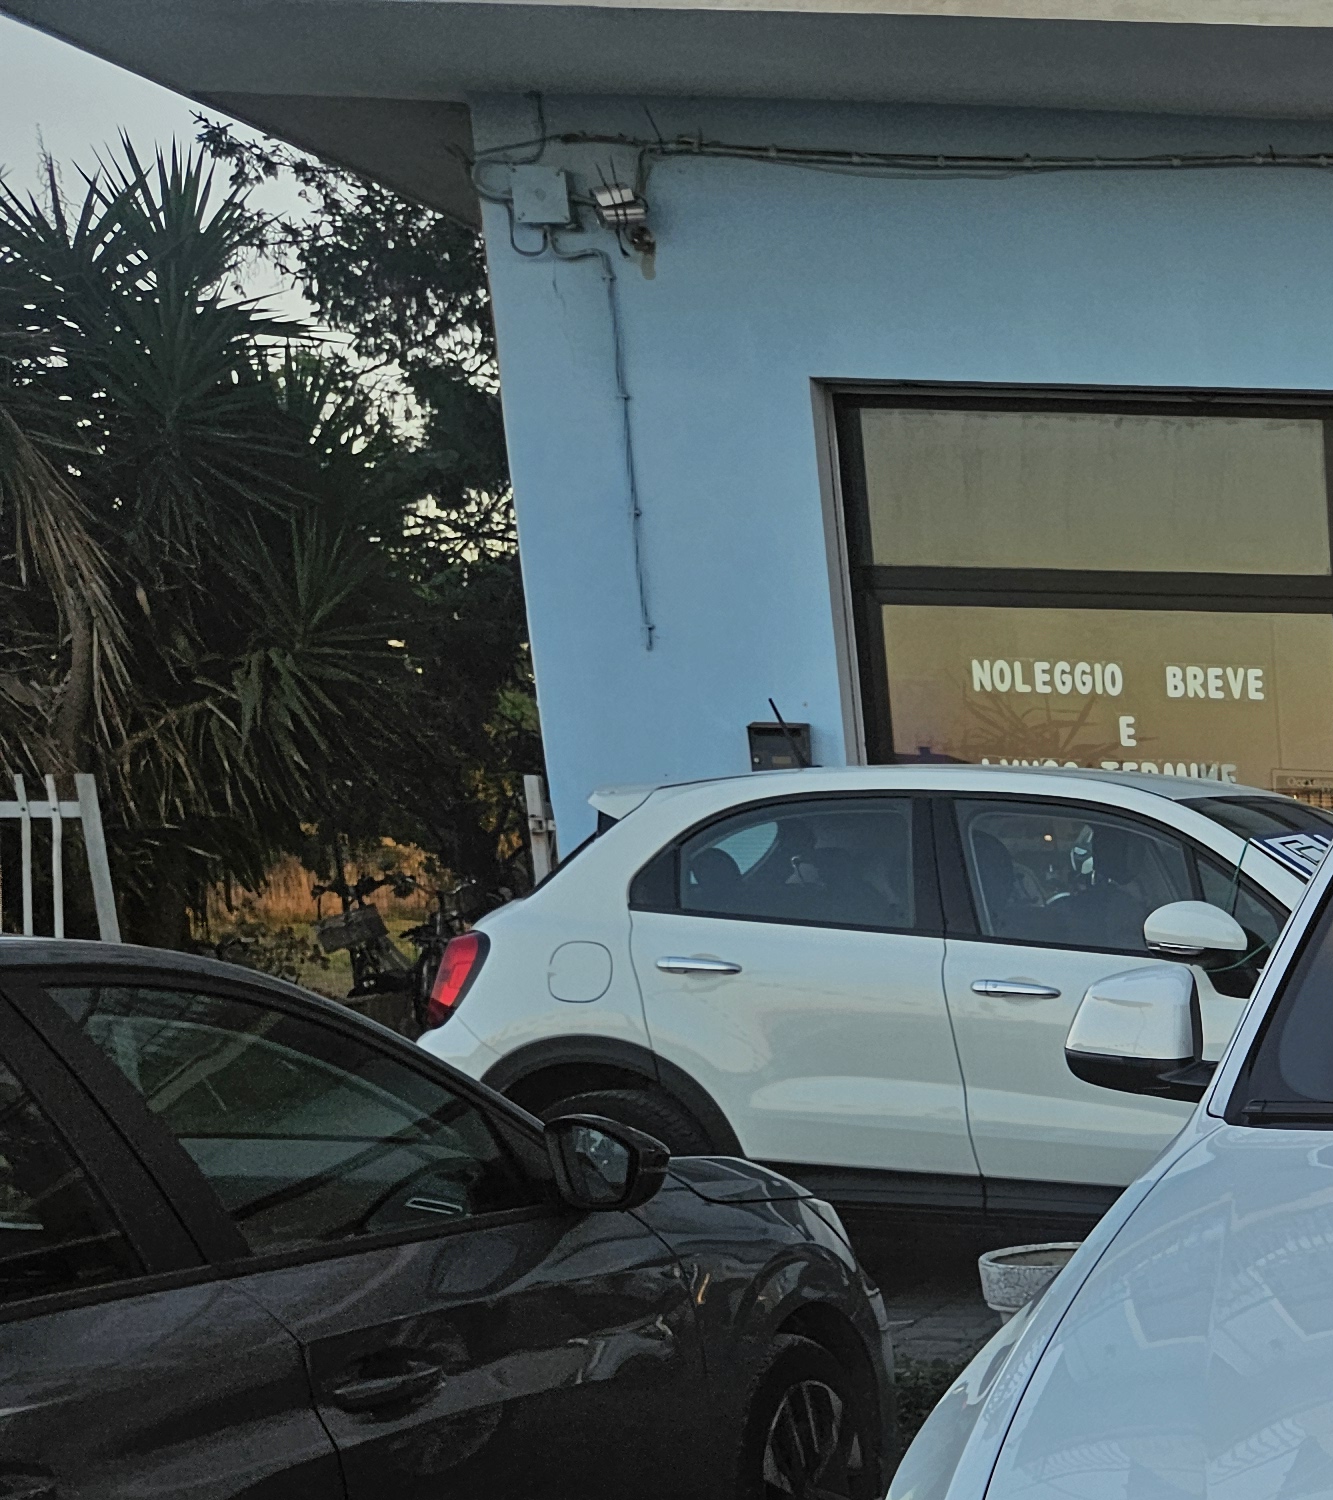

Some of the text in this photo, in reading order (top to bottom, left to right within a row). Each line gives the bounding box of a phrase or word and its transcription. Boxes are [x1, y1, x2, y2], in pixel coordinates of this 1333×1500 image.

[971, 659, 1265, 700] NOLEGGIO BREVE
[1118, 715, 1137, 747] E
